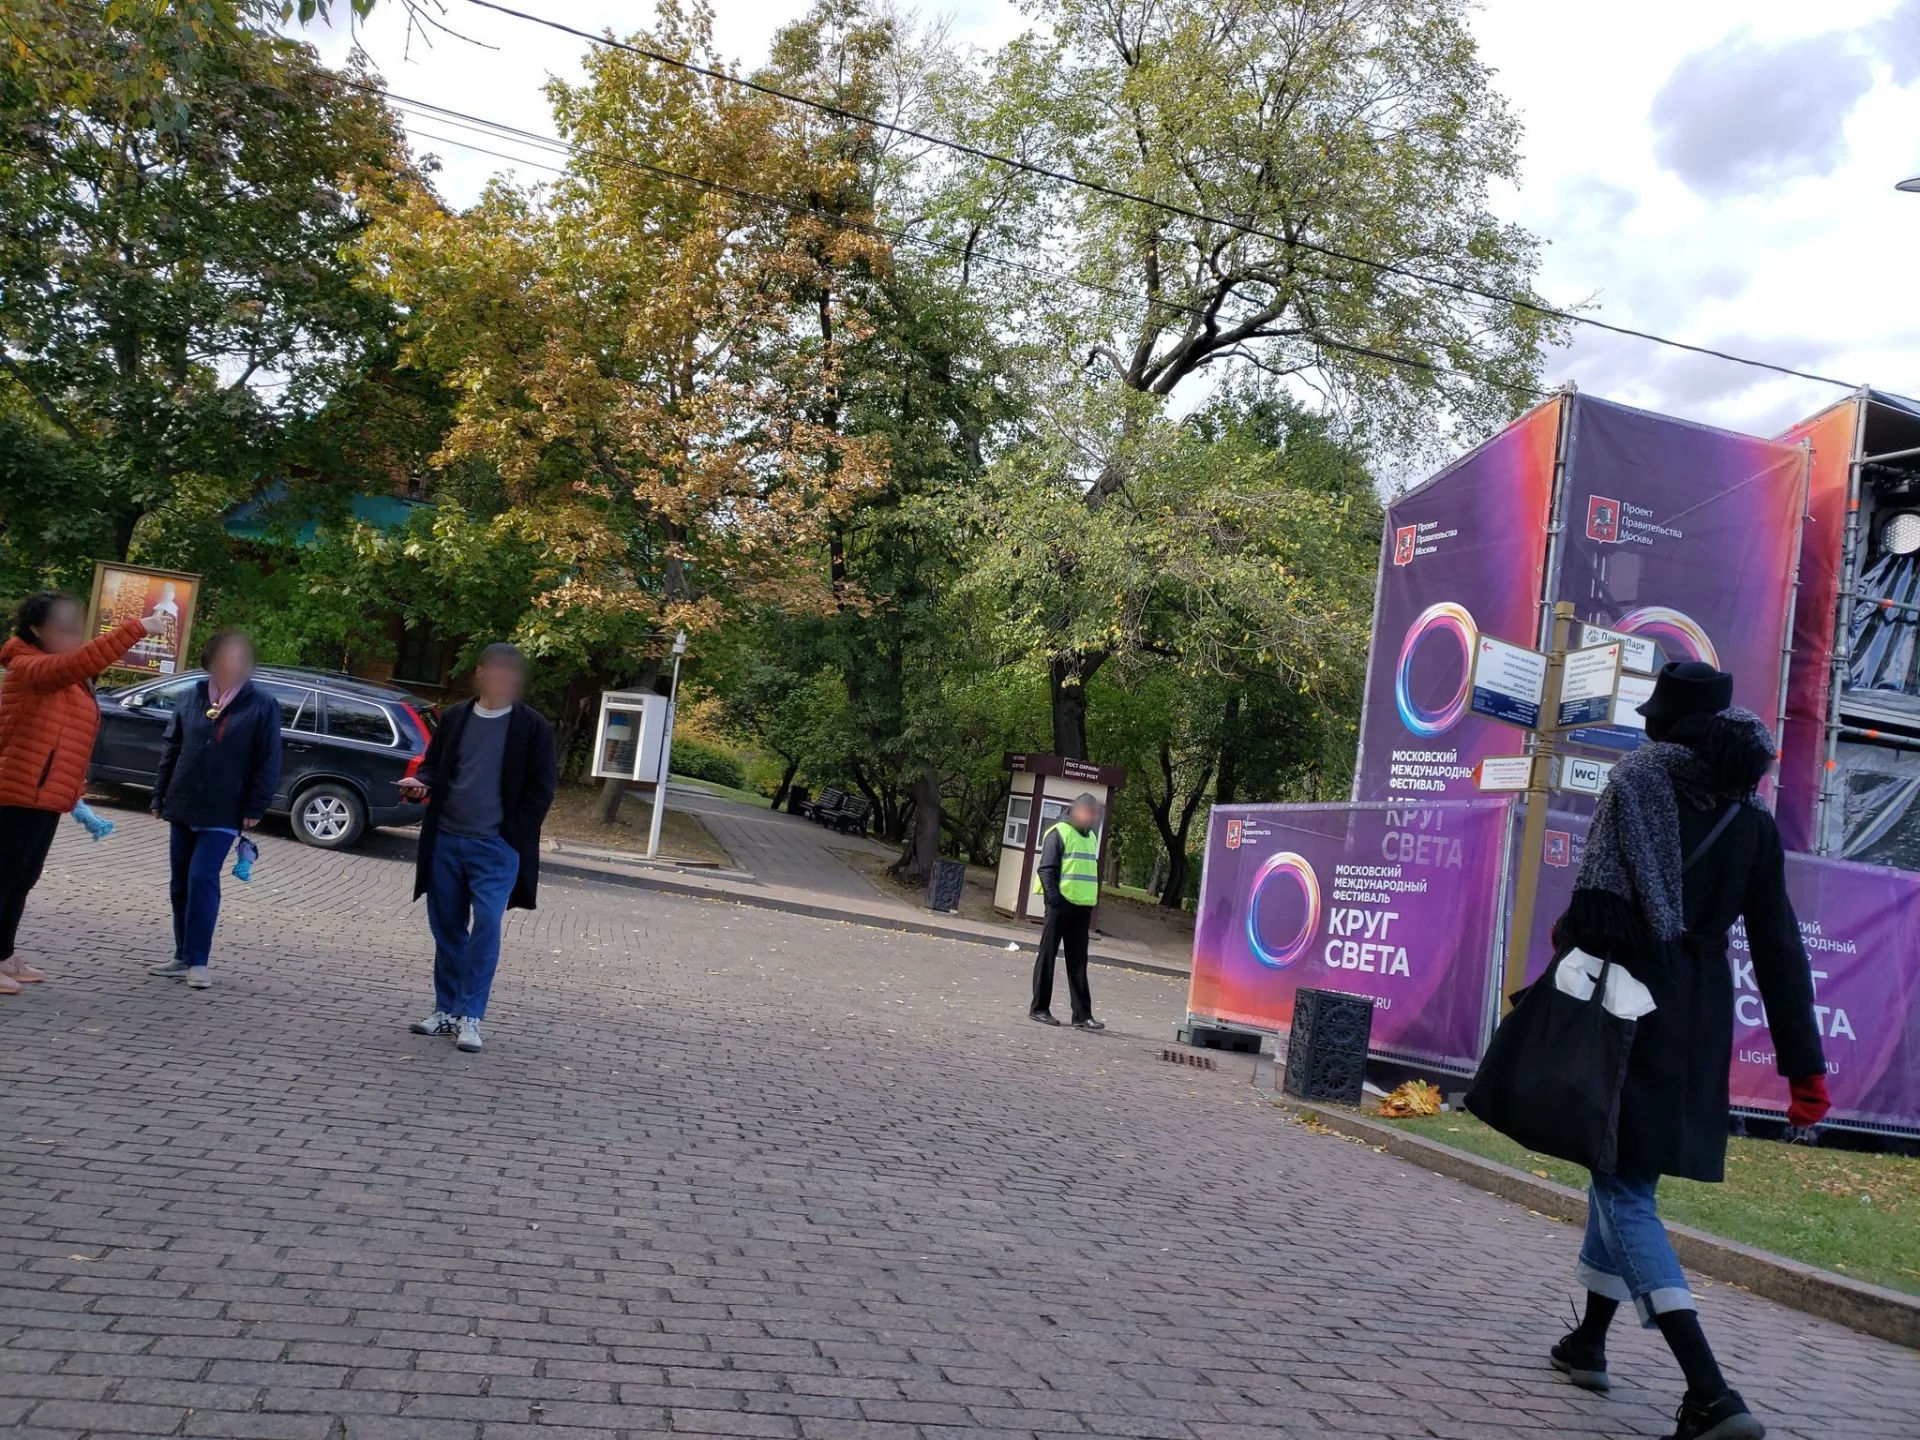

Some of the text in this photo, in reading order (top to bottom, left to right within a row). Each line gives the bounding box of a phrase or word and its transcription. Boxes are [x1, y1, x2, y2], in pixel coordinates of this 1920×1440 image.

[1623, 502, 1654, 518] Проект
[1417, 521, 1438, 533] Проект
[1621, 516, 1683, 539] Правительства
[1416, 529, 1458, 545] Правительства
[1620, 529, 1654, 546] Москвы
[1415, 545, 1438, 556] Москвы
[1392, 748, 1457, 763] МОСКОВСКИЙ
[1064, 769, 1086, 778] SECURITY
[1066, 761, 1100, 772] ПОСТ ОХРАНЫ
[1390, 764, 1474, 779] МЕЖДУНАРОДНЫ
[1574, 768, 1597, 781] WC
[1389, 777, 1446, 792] ФЕСТИВАЛЬ
[1572, 833, 1588, 844] Про
[1381, 830, 1463, 869] СВЕТА
[1335, 864, 1402, 878] МОСКОВСКИЙ
[1334, 877, 1428, 893] МЕЖДУНАРОДНЫЙ
[1332, 890, 1391, 904] ФЕСТИВАЛЬ
[1328, 907, 1400, 940] КРУГ
[1324, 939, 1411, 978] СВЕТА
[1735, 994, 1857, 1041] СТА
